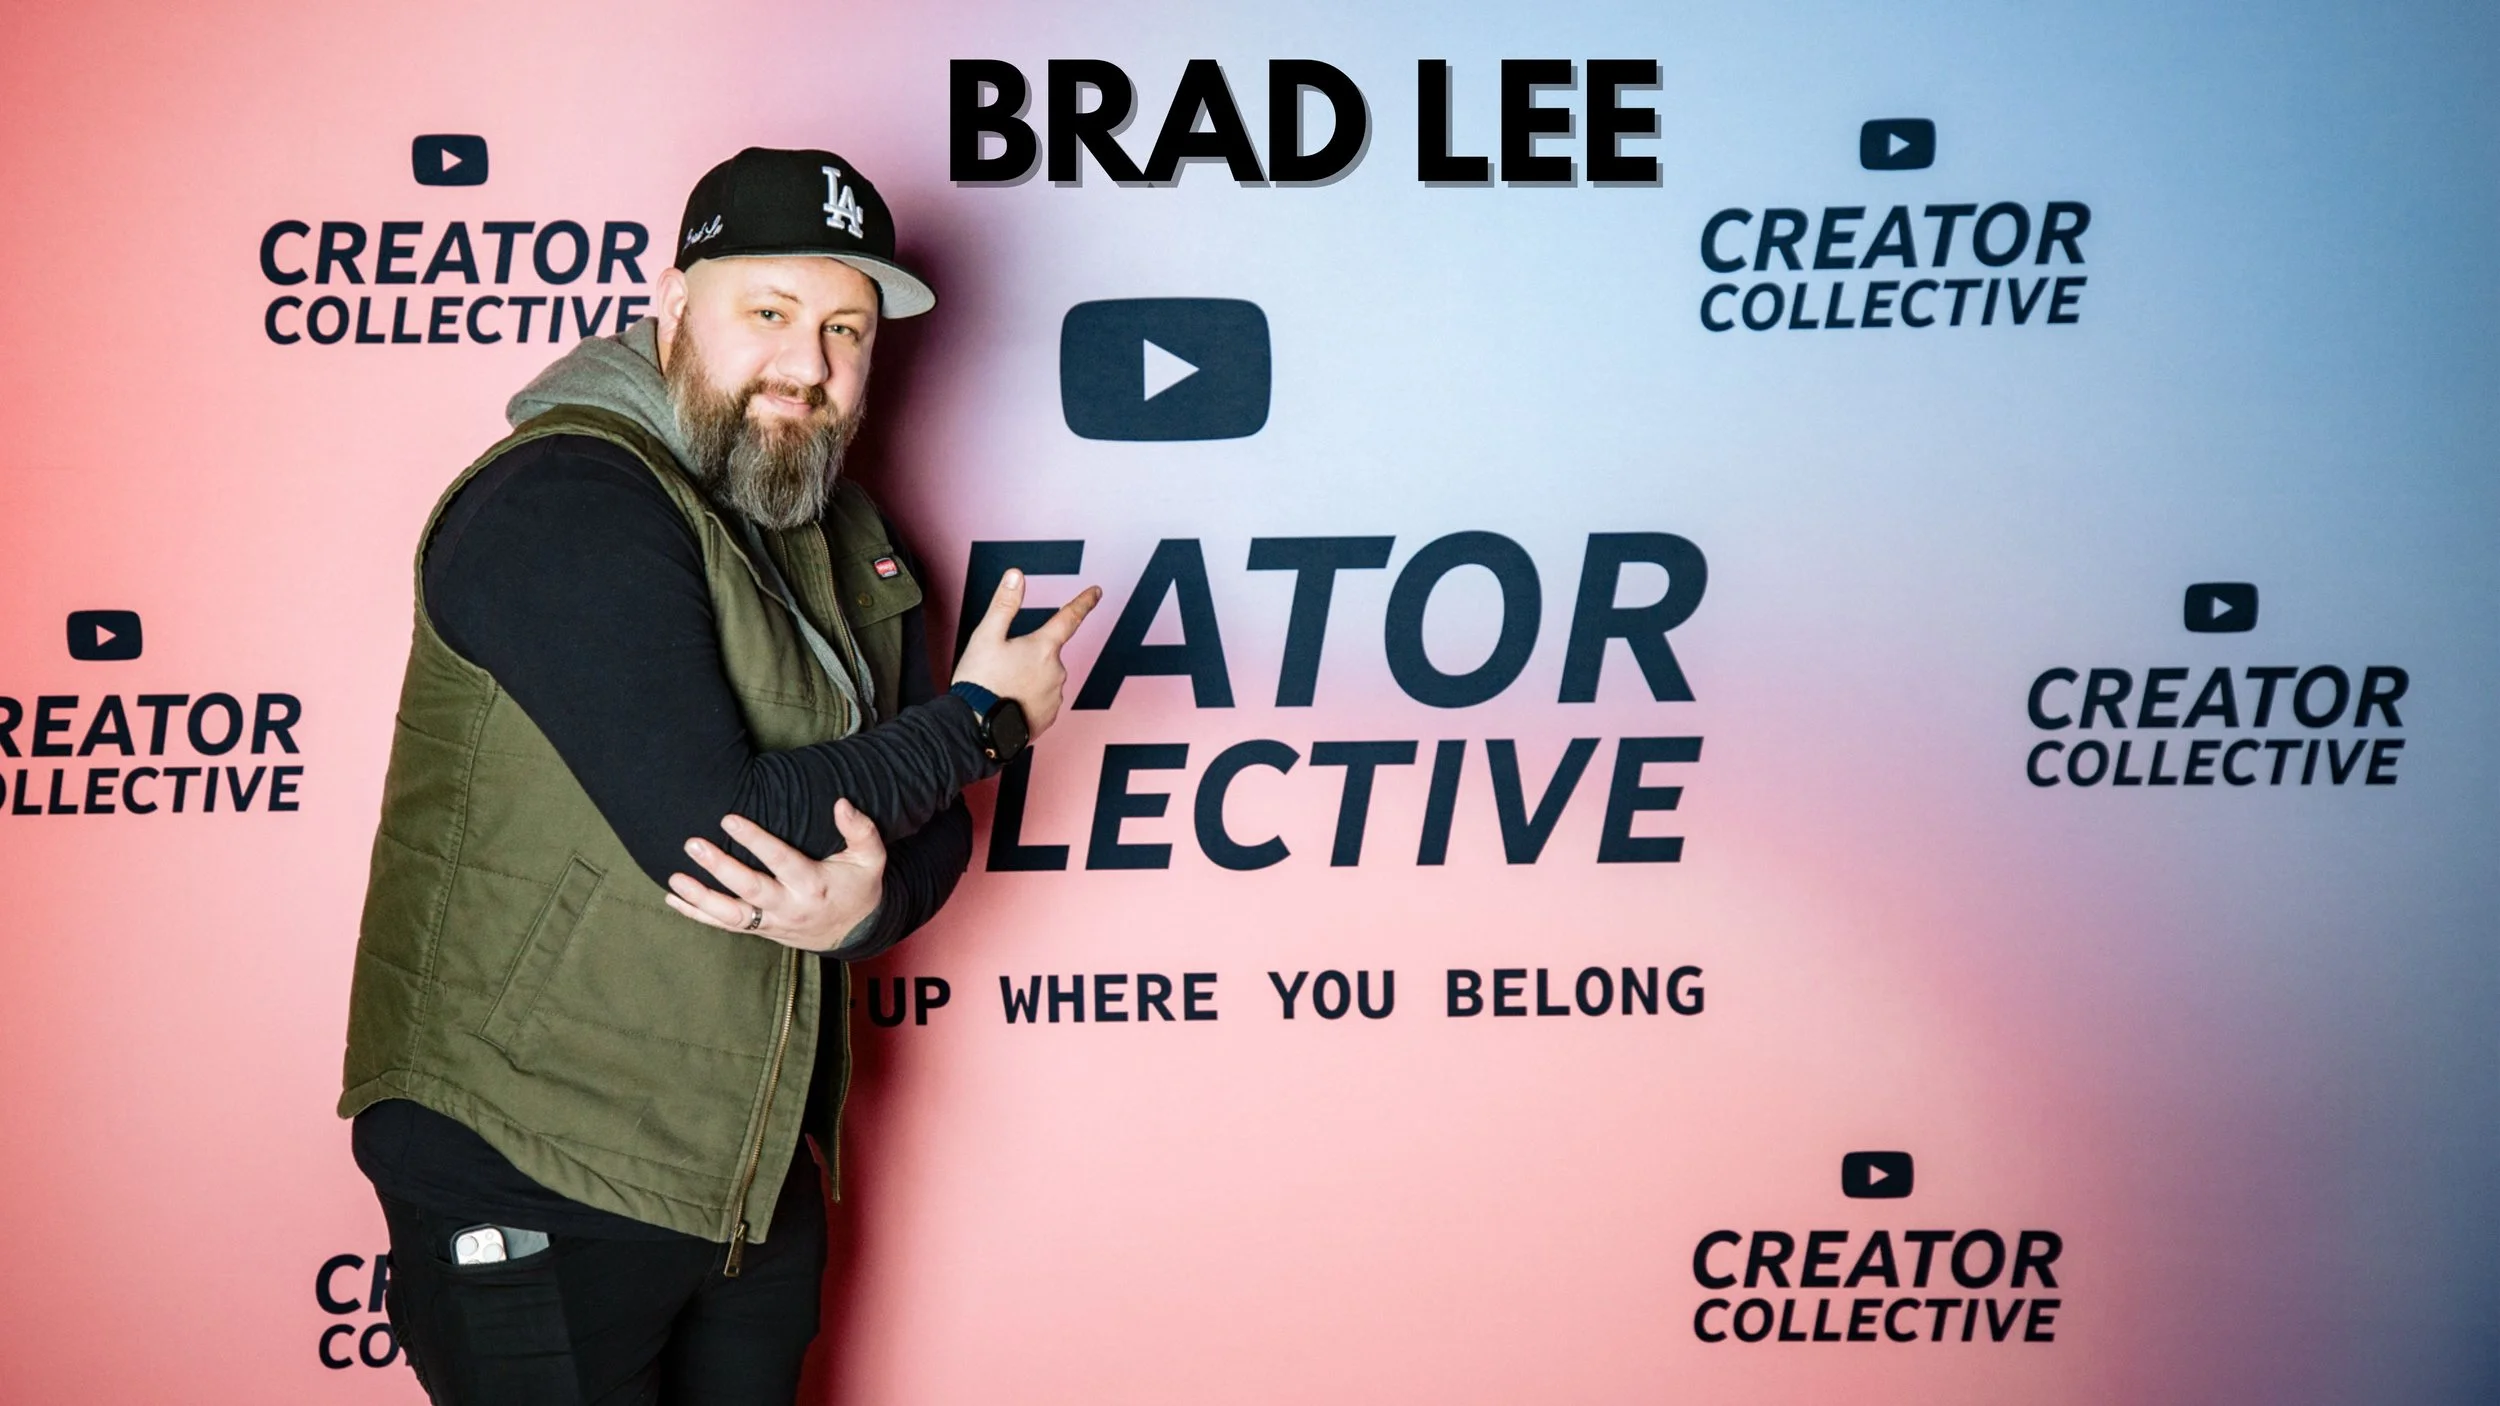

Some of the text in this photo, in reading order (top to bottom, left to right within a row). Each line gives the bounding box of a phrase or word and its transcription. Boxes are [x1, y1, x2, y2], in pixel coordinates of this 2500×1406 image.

[822, 165, 863, 239] LA
[260, 220, 649, 285] CREATOR
[1701, 201, 2090, 273] CREATOR
[1701, 276, 2087, 332] COLLECTIVE
[2027, 665, 2409, 730] CREATOR
[0, 766, 304, 815] LLECTIVE
[2026, 738, 2405, 788] COLLECTIVE
[999, 973, 1218, 1024] WHERE
[1268, 970, 1395, 1020] YOU
[1447, 965, 1705, 1018] BELONG
[1693, 1229, 2063, 1290] CREATOR
[1694, 1297, 2062, 1343] COLLECTIVE
